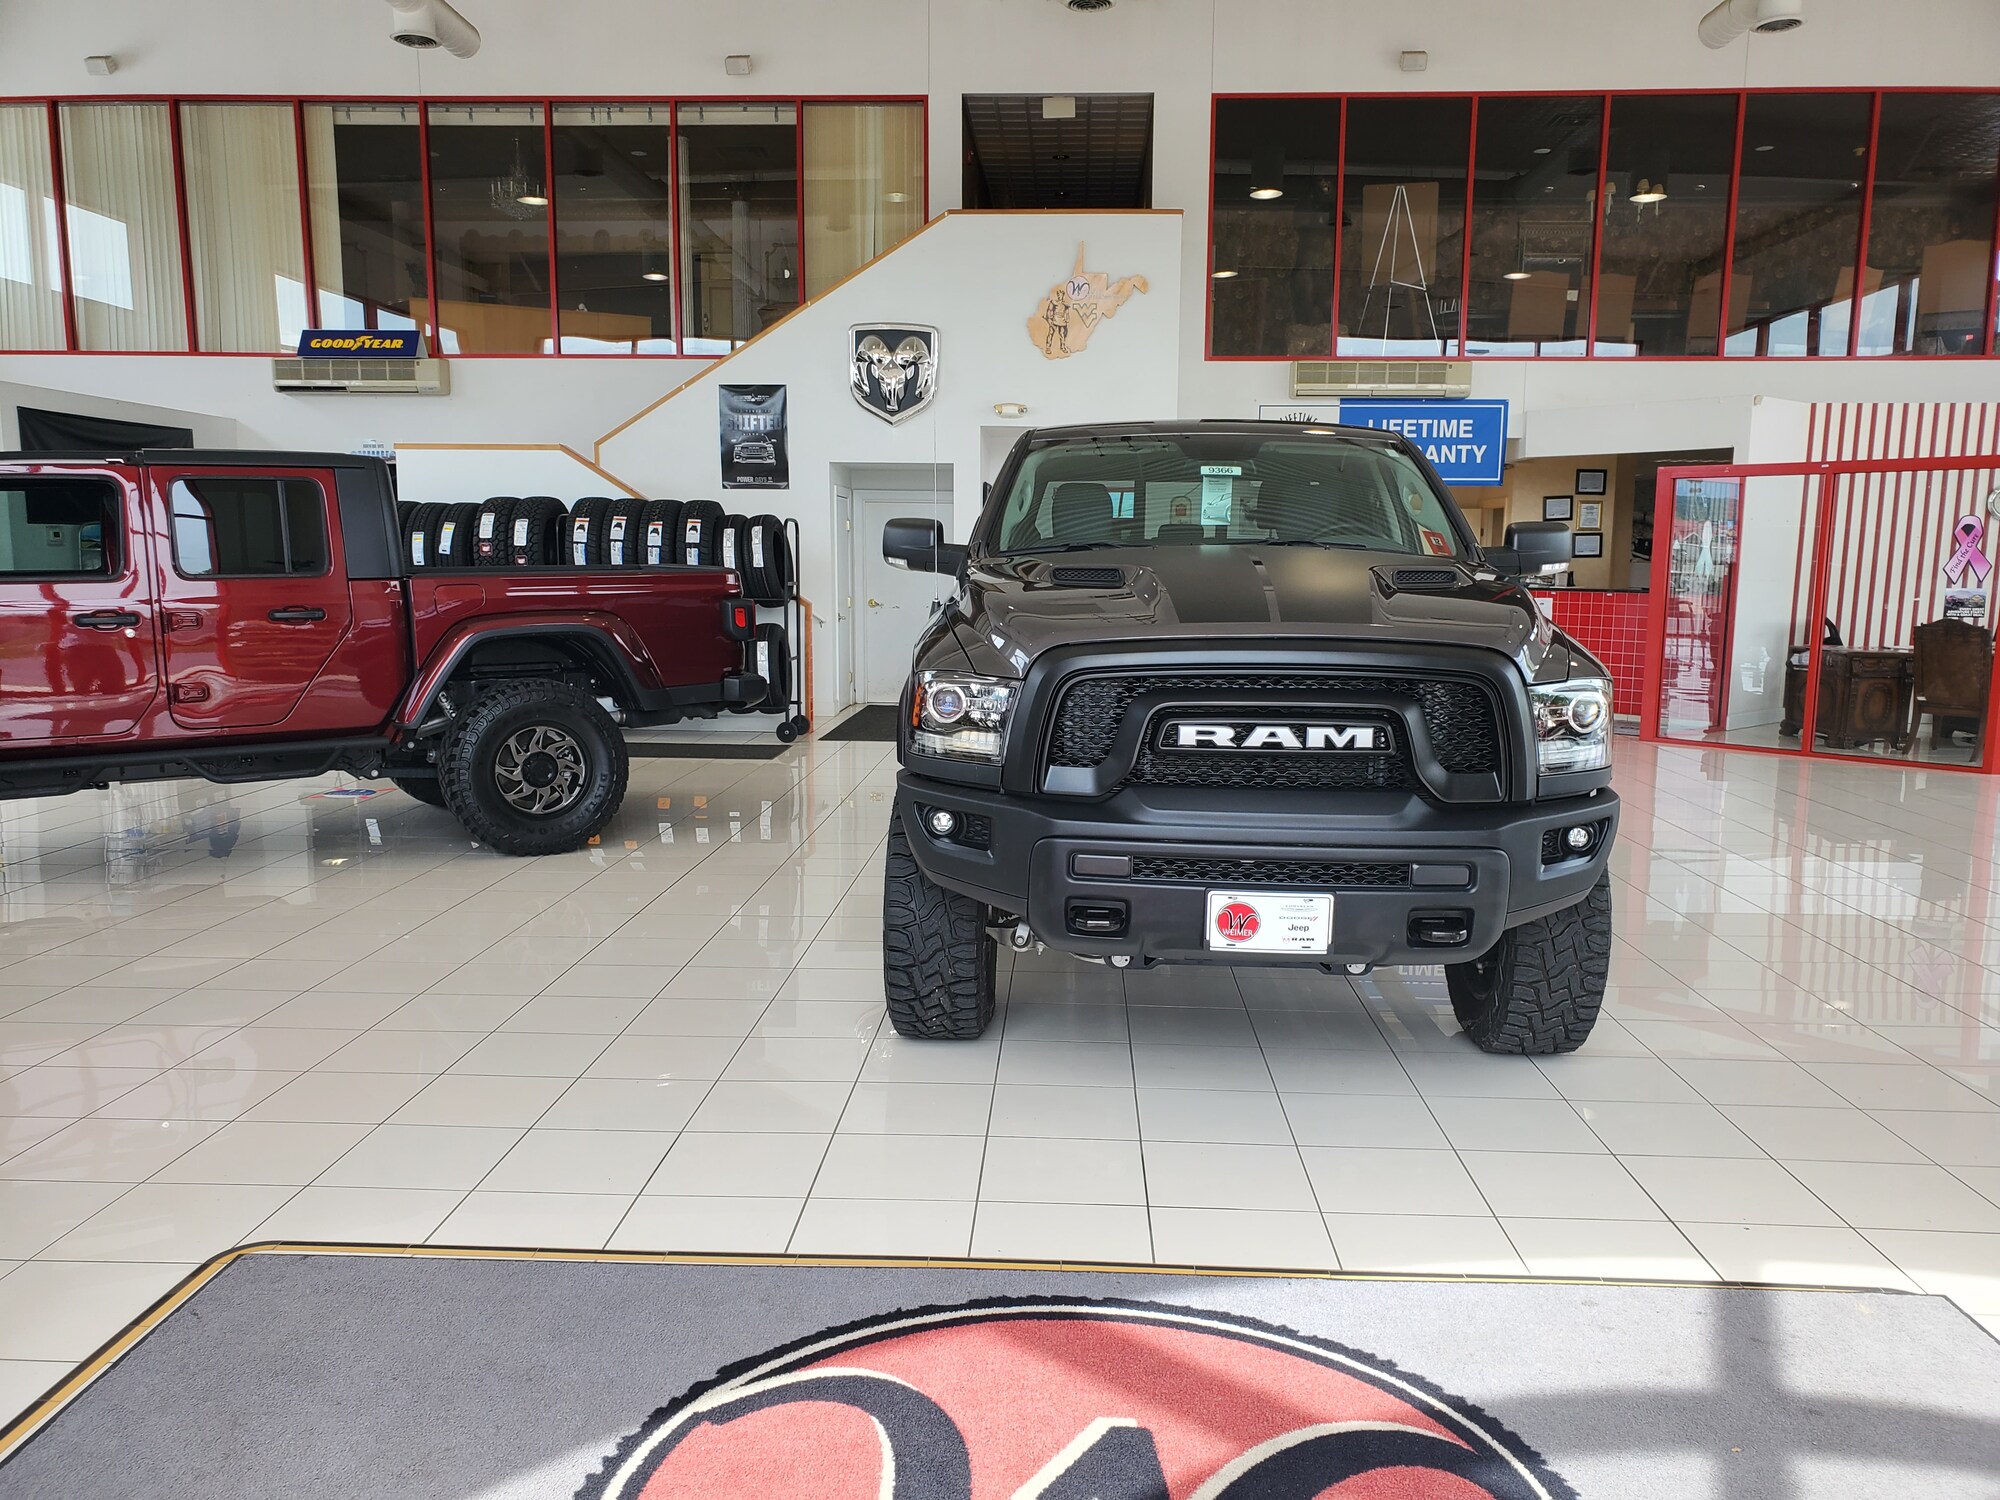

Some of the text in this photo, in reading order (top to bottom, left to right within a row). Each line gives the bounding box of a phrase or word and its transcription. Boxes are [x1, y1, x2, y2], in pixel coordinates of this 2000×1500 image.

[310, 336, 404, 350] GOODYEAR
[727, 414, 783, 431] SHIFTED
[1417, 445, 1487, 464] ANTY
[1949, 534, 1979, 574] Find the Cure
[1178, 725, 1374, 748] RAM
[1222, 928, 1254, 937] WEIMER
[1288, 923, 1310, 932] Jeep
